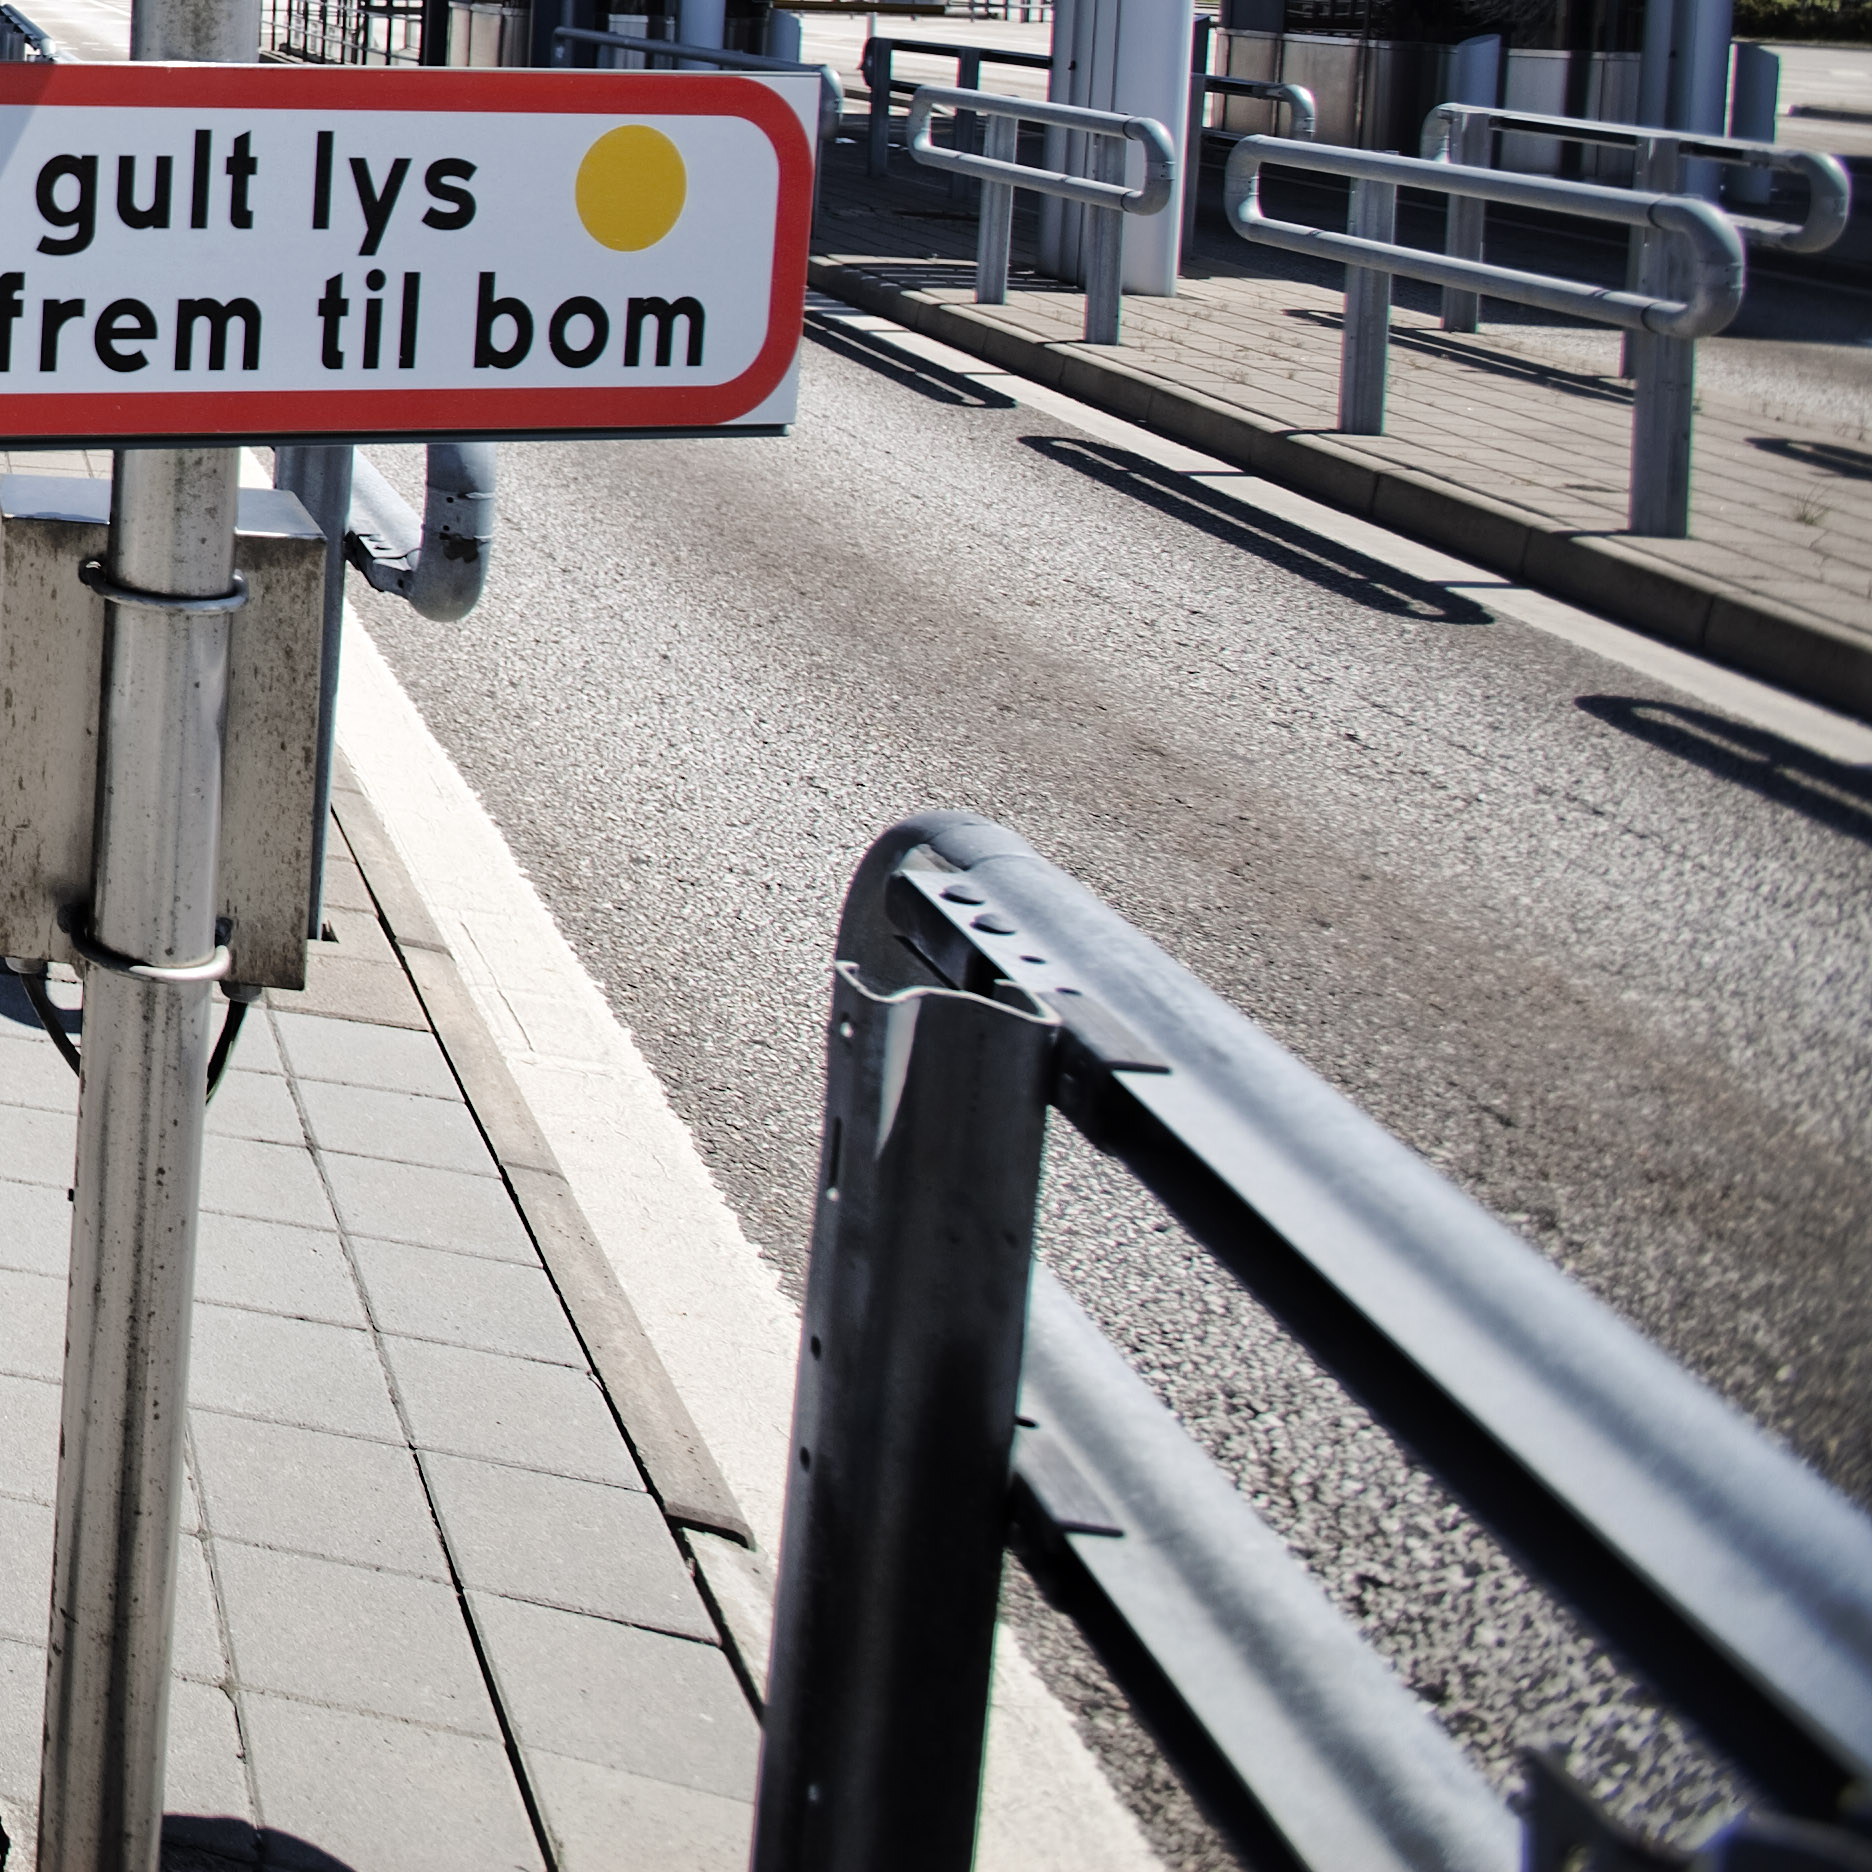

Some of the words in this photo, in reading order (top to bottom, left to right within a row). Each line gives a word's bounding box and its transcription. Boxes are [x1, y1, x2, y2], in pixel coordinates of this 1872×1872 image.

[36, 131, 257, 256] gult
[313, 131, 477, 256] lys
[318, 269, 420, 369] til
[474, 272, 705, 369] bom
